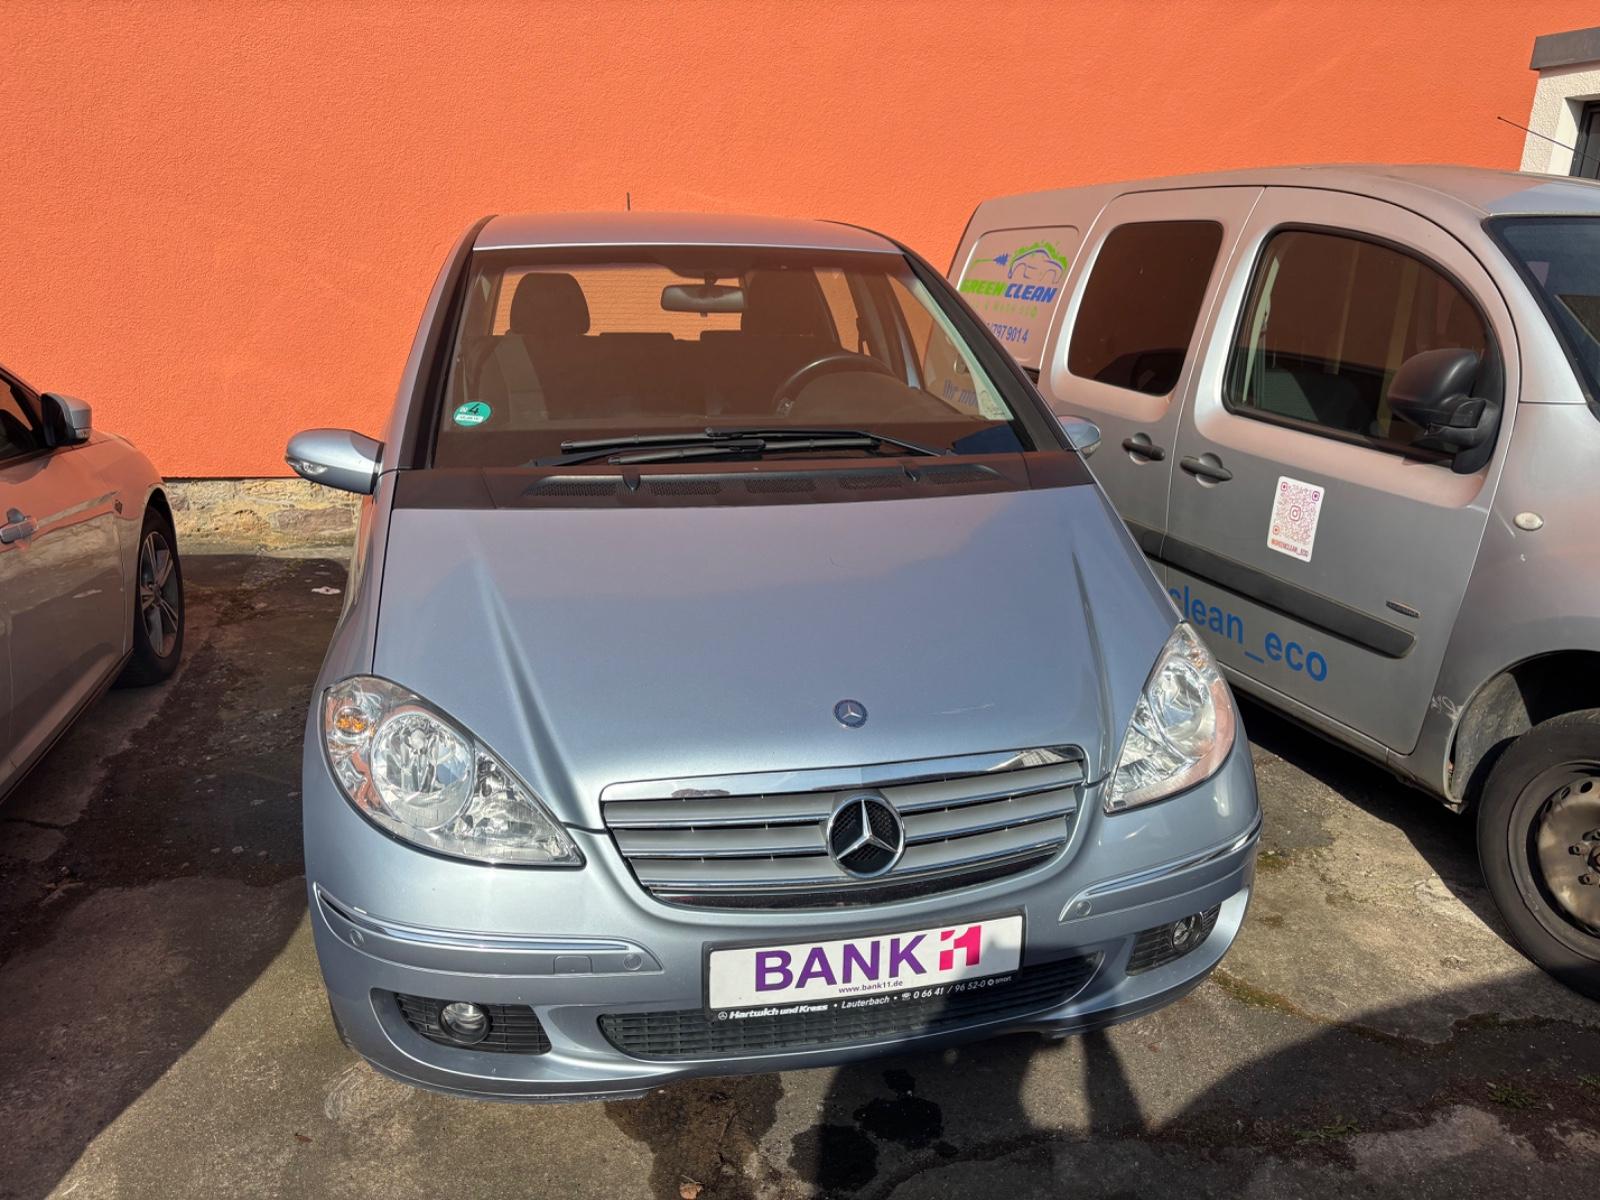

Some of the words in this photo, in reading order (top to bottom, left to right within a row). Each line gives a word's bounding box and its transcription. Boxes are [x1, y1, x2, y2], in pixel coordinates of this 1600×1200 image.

[755, 934, 927, 992] BANK
[780, 1006, 799, 1015] und
[841, 996, 890, 1009] Lauterbach
[921, 989, 932, 998] 66
[934, 987, 944, 995] 41
[955, 983, 965, 992] 96
[838, 981, 903, 993] www.bank11.de
